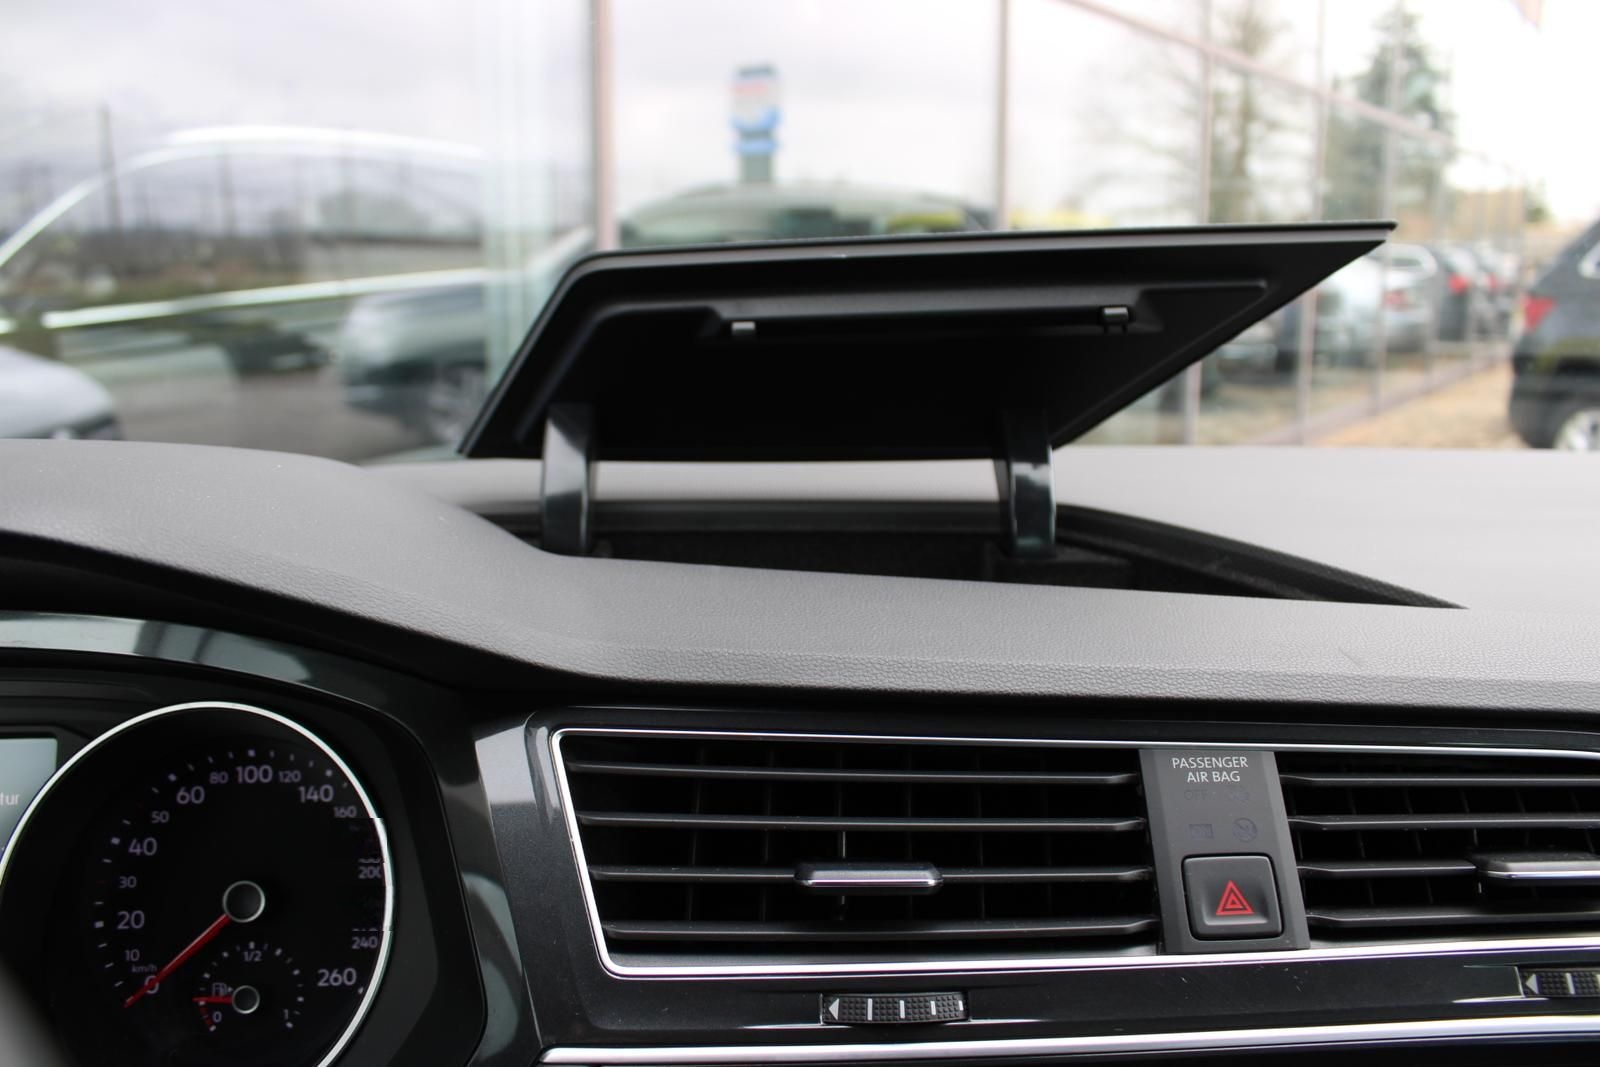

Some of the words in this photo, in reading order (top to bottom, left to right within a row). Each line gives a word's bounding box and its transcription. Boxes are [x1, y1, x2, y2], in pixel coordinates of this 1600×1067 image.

[1172, 756, 1248, 769] PASSENGER
[209, 771, 229, 784] 80
[236, 765, 273, 784] 100
[278, 770, 301, 783] 120
[1187, 771, 1208, 783] AIR
[1212, 770, 1240, 782] BAG
[176, 785, 205, 804] 60
[298, 784, 334, 803] 140
[151, 810, 170, 824] 50
[333, 805, 357, 818] 160
[128, 837, 158, 856] 40
[119, 875, 137, 889] 30
[117, 911, 145, 930] 20
[352, 936, 378, 949] 240
[125, 949, 140, 962] 10
[243, 950, 262, 962] 1/2
[131, 963, 157, 973] km/h
[317, 967, 357, 987] 260
[144, 975, 160, 994] 0
[212, 1010, 222, 1023] 0
